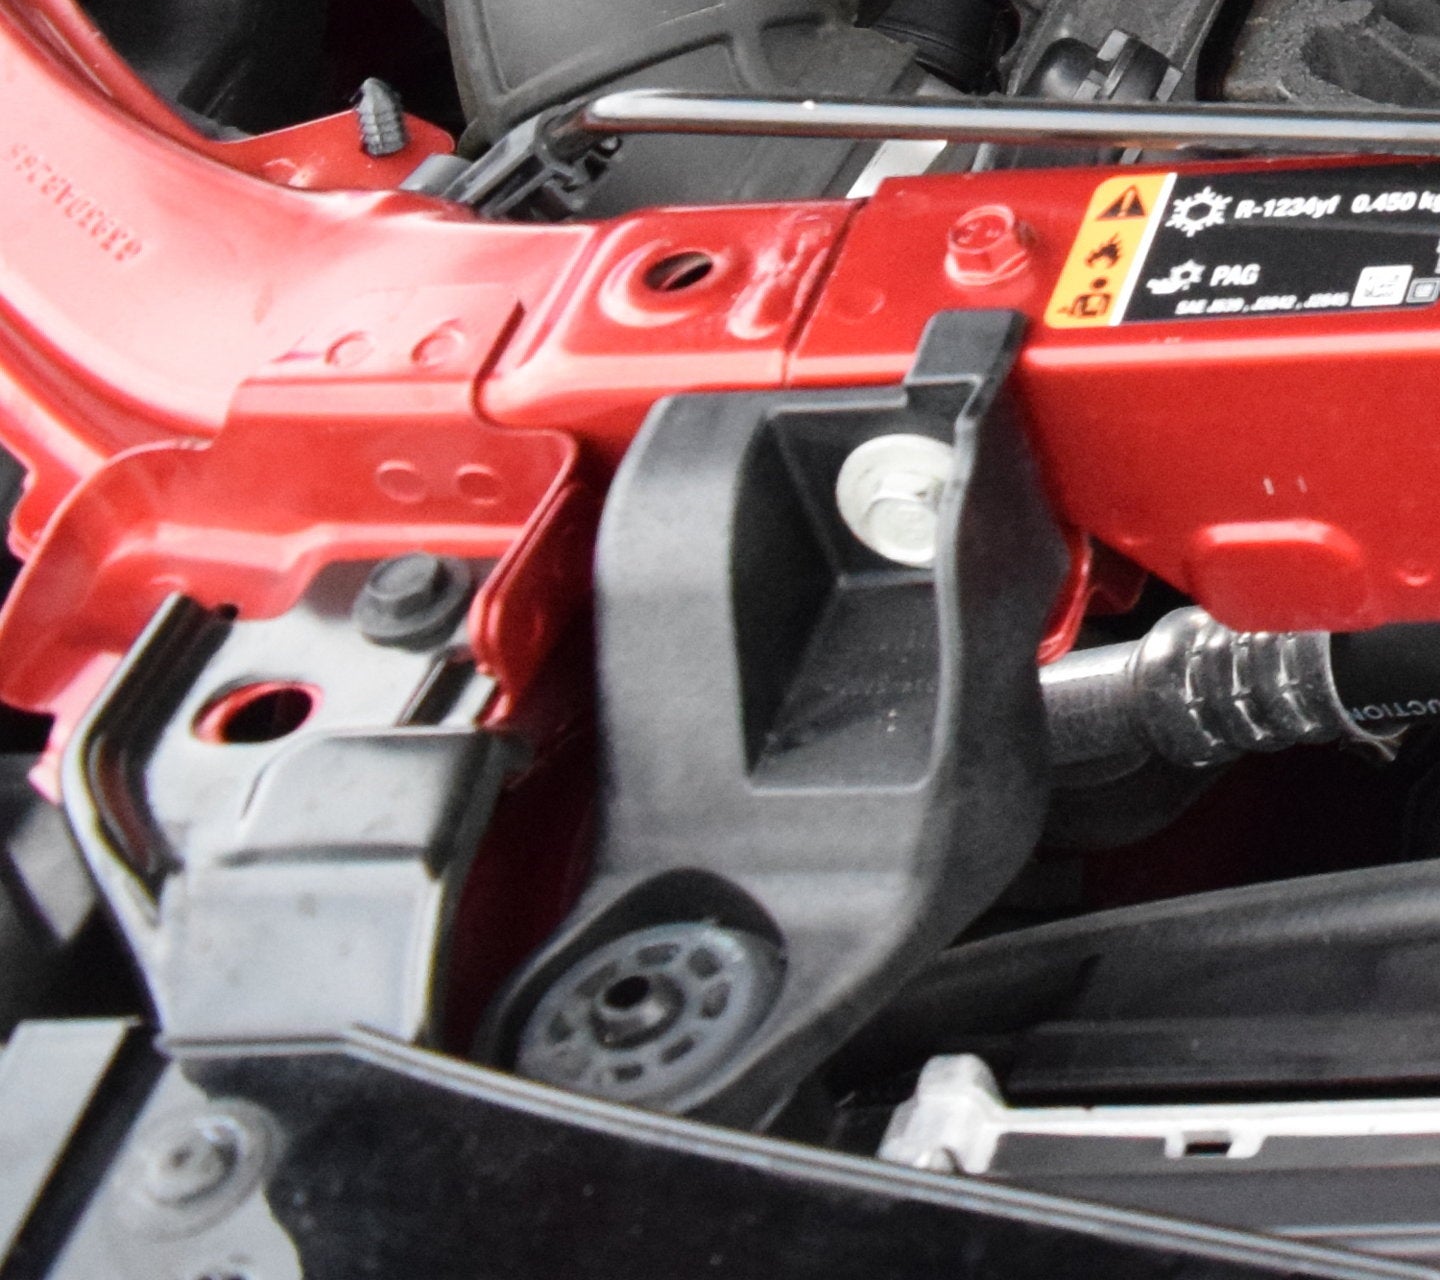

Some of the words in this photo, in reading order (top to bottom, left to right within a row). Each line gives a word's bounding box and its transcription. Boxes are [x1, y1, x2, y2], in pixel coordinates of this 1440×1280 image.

[1234, 196, 1338, 219] R-1234yf
[1352, 193, 1417, 213] 0.450
[1210, 265, 1260, 287] PAG
